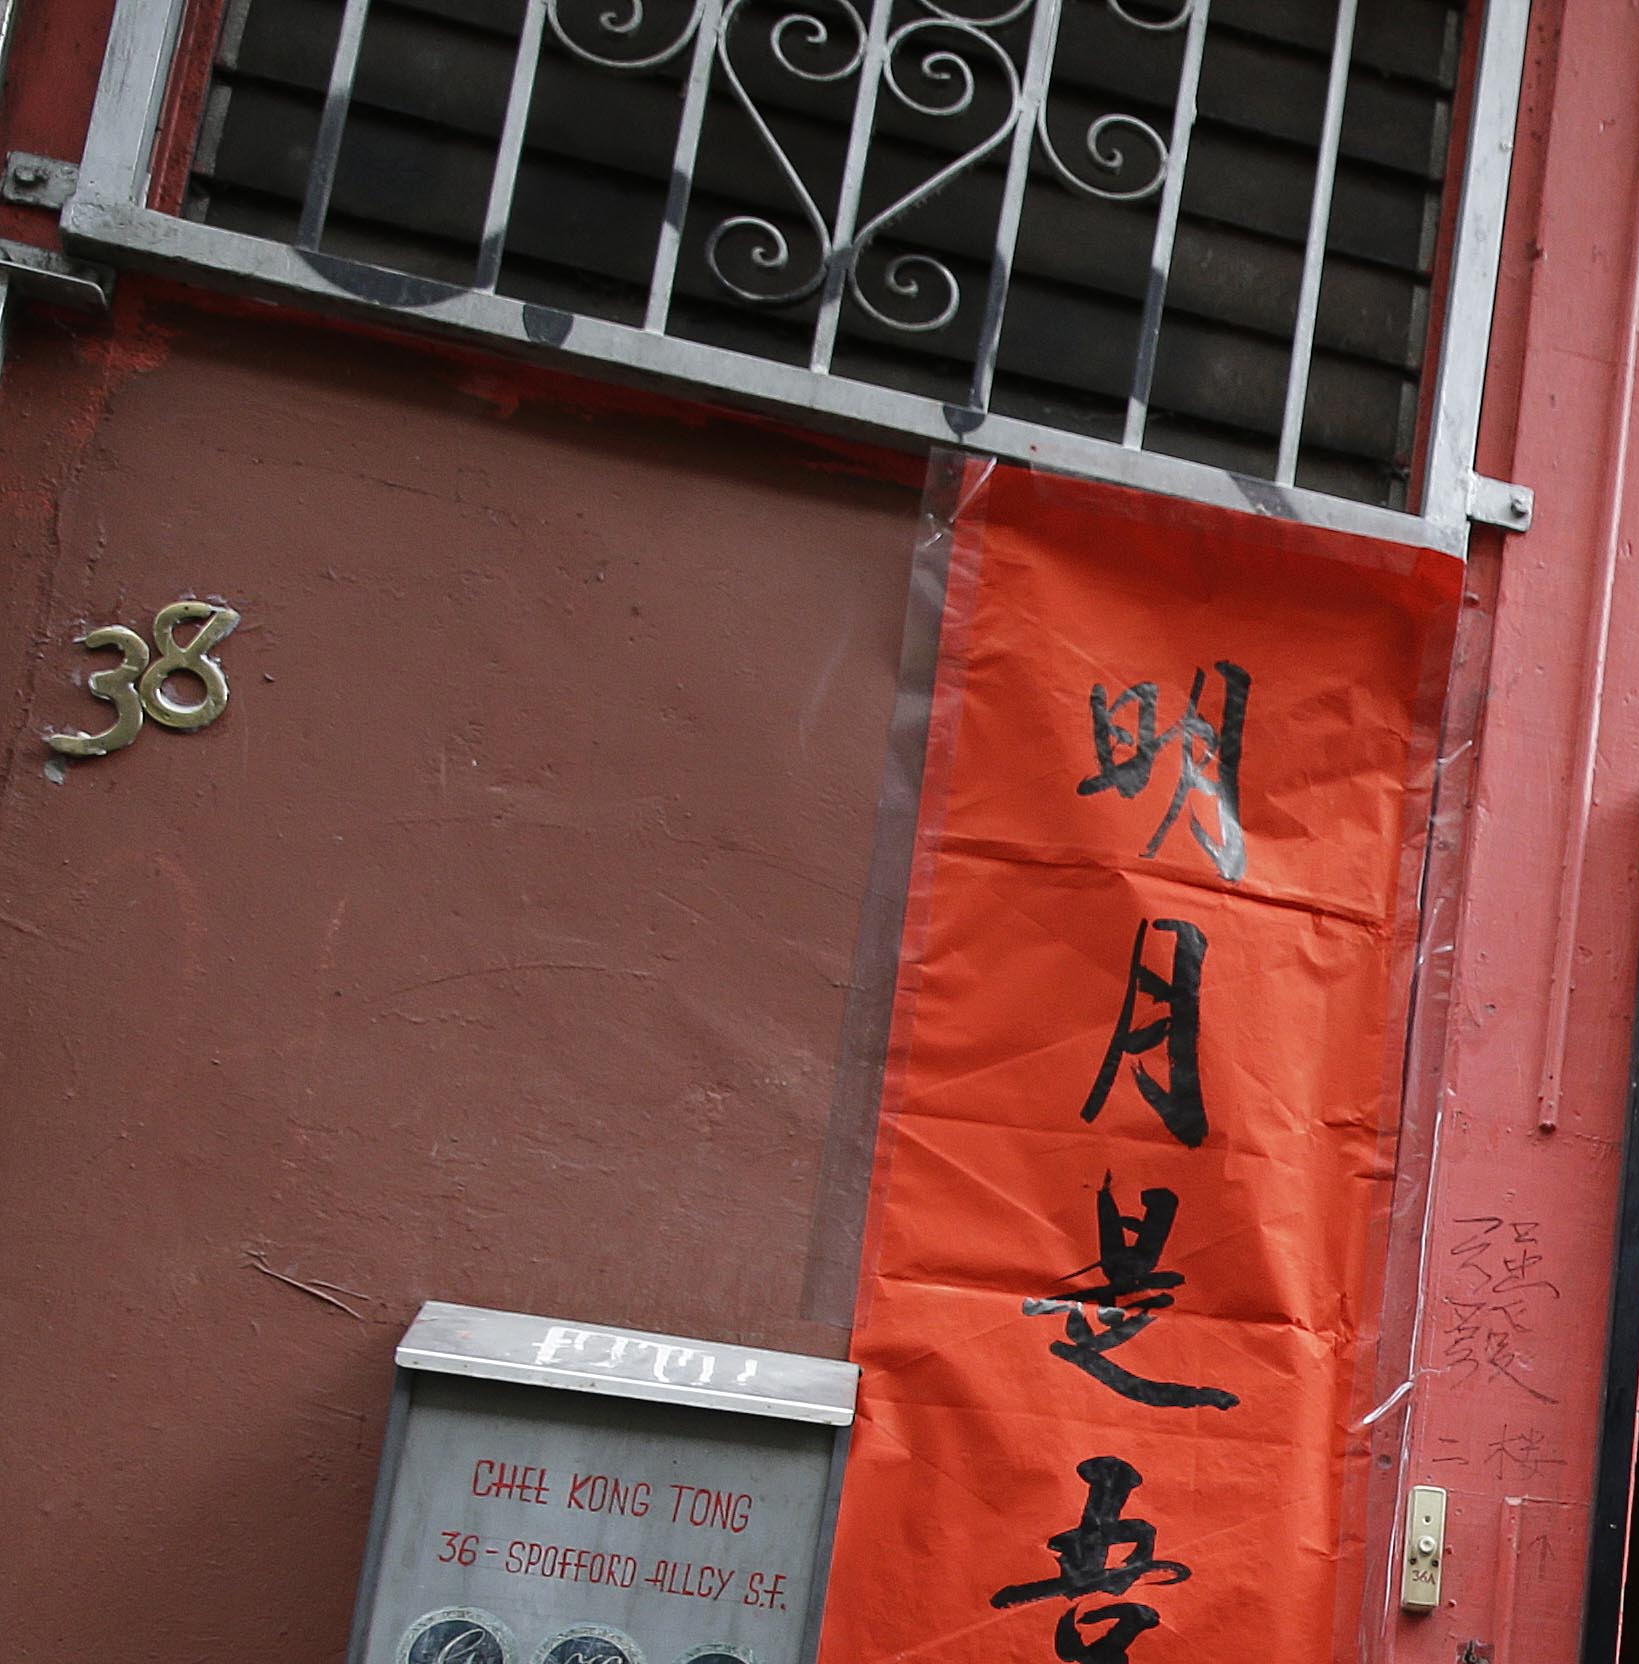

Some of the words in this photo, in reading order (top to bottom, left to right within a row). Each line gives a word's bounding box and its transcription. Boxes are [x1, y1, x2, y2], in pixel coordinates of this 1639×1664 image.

[49, 600, 241, 756] 38
[567, 1472, 651, 1518] KONG
[671, 1483, 754, 1534] TONG
[505, 1539, 637, 1589] SPOFFORD
[743, 1571, 787, 1611] S.F.
